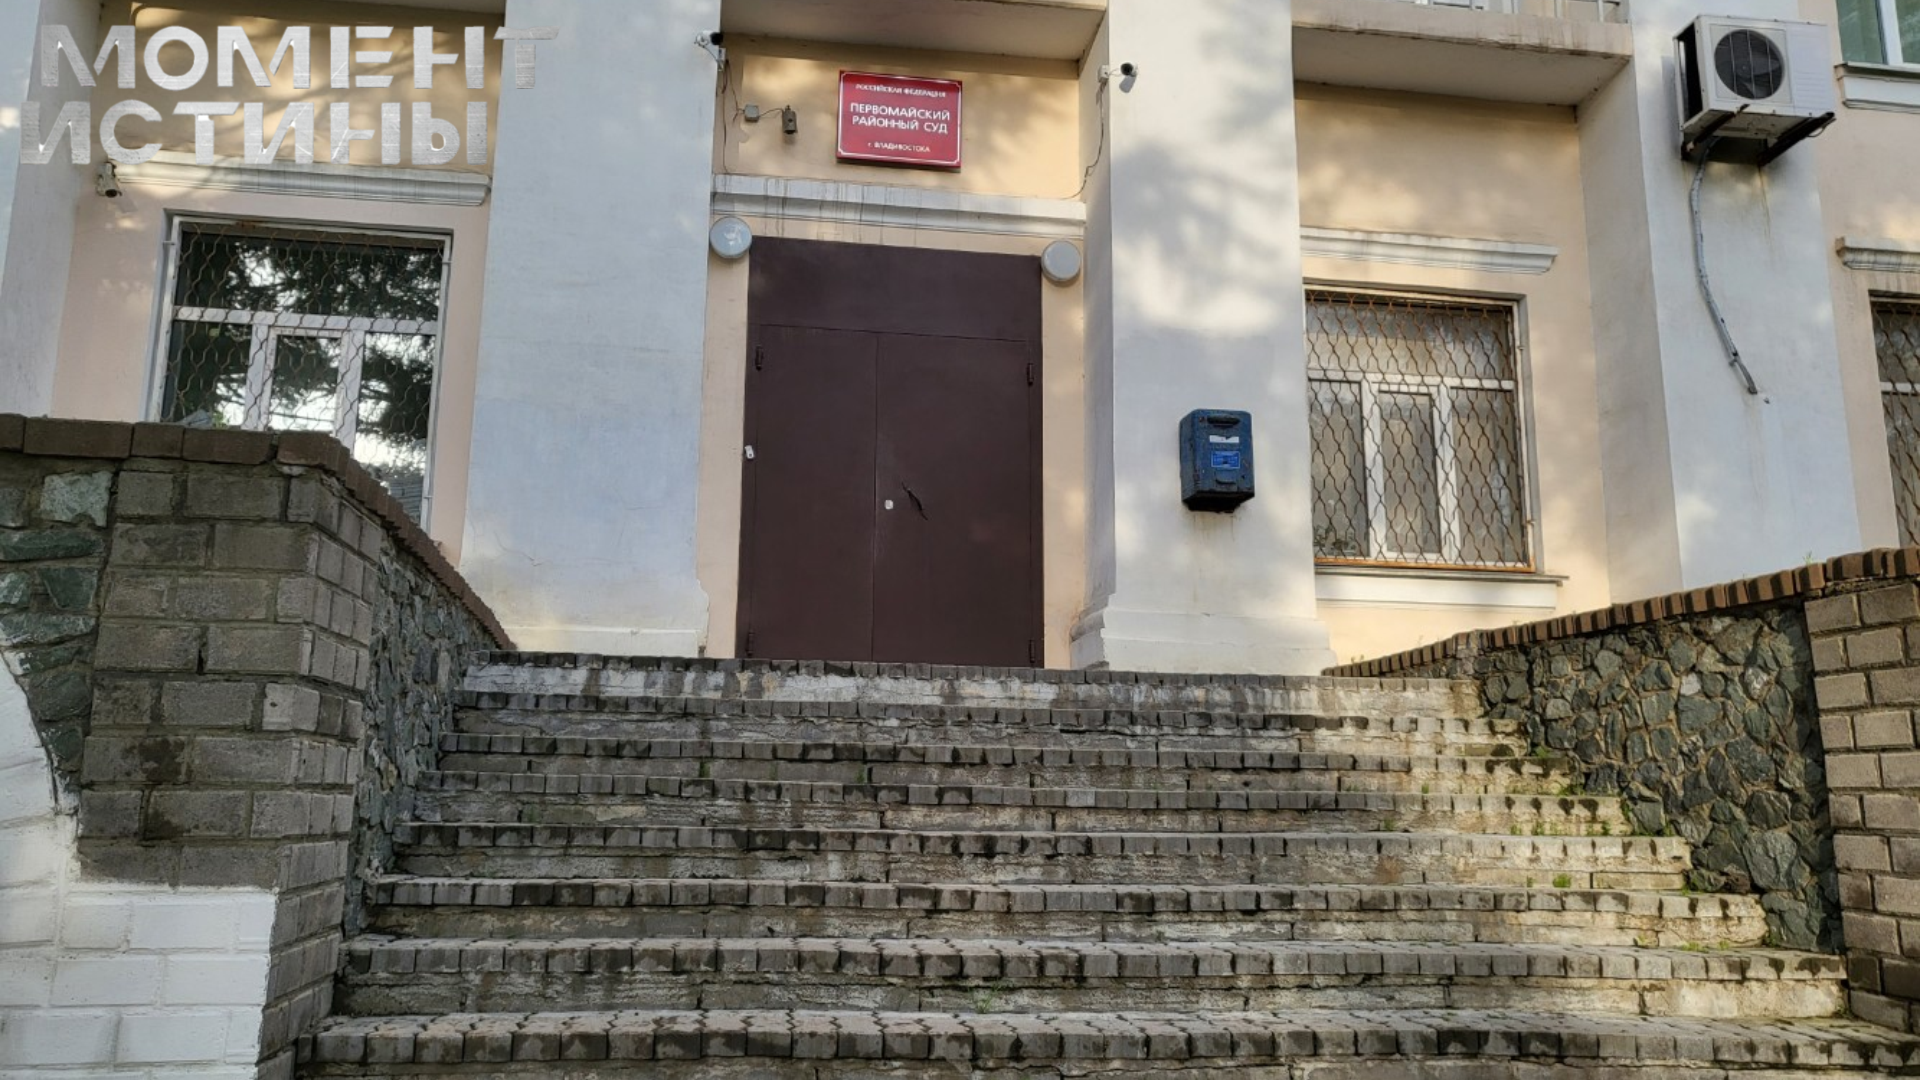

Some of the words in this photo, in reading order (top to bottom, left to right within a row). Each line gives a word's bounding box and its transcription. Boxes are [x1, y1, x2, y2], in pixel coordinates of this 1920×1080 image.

[856, 83, 902, 94] РОССИЙСКАЯ
[903, 88, 946, 98] ФЕДЕРАЦИЯ
[850, 102, 950, 121] ПЕРВОМАЙСКИЙ
[852, 115, 919, 130] РАЙОННЫЙ
[923, 122, 948, 134] СУД
[874, 142, 931, 152] ВЛАДИВОСТОКА
